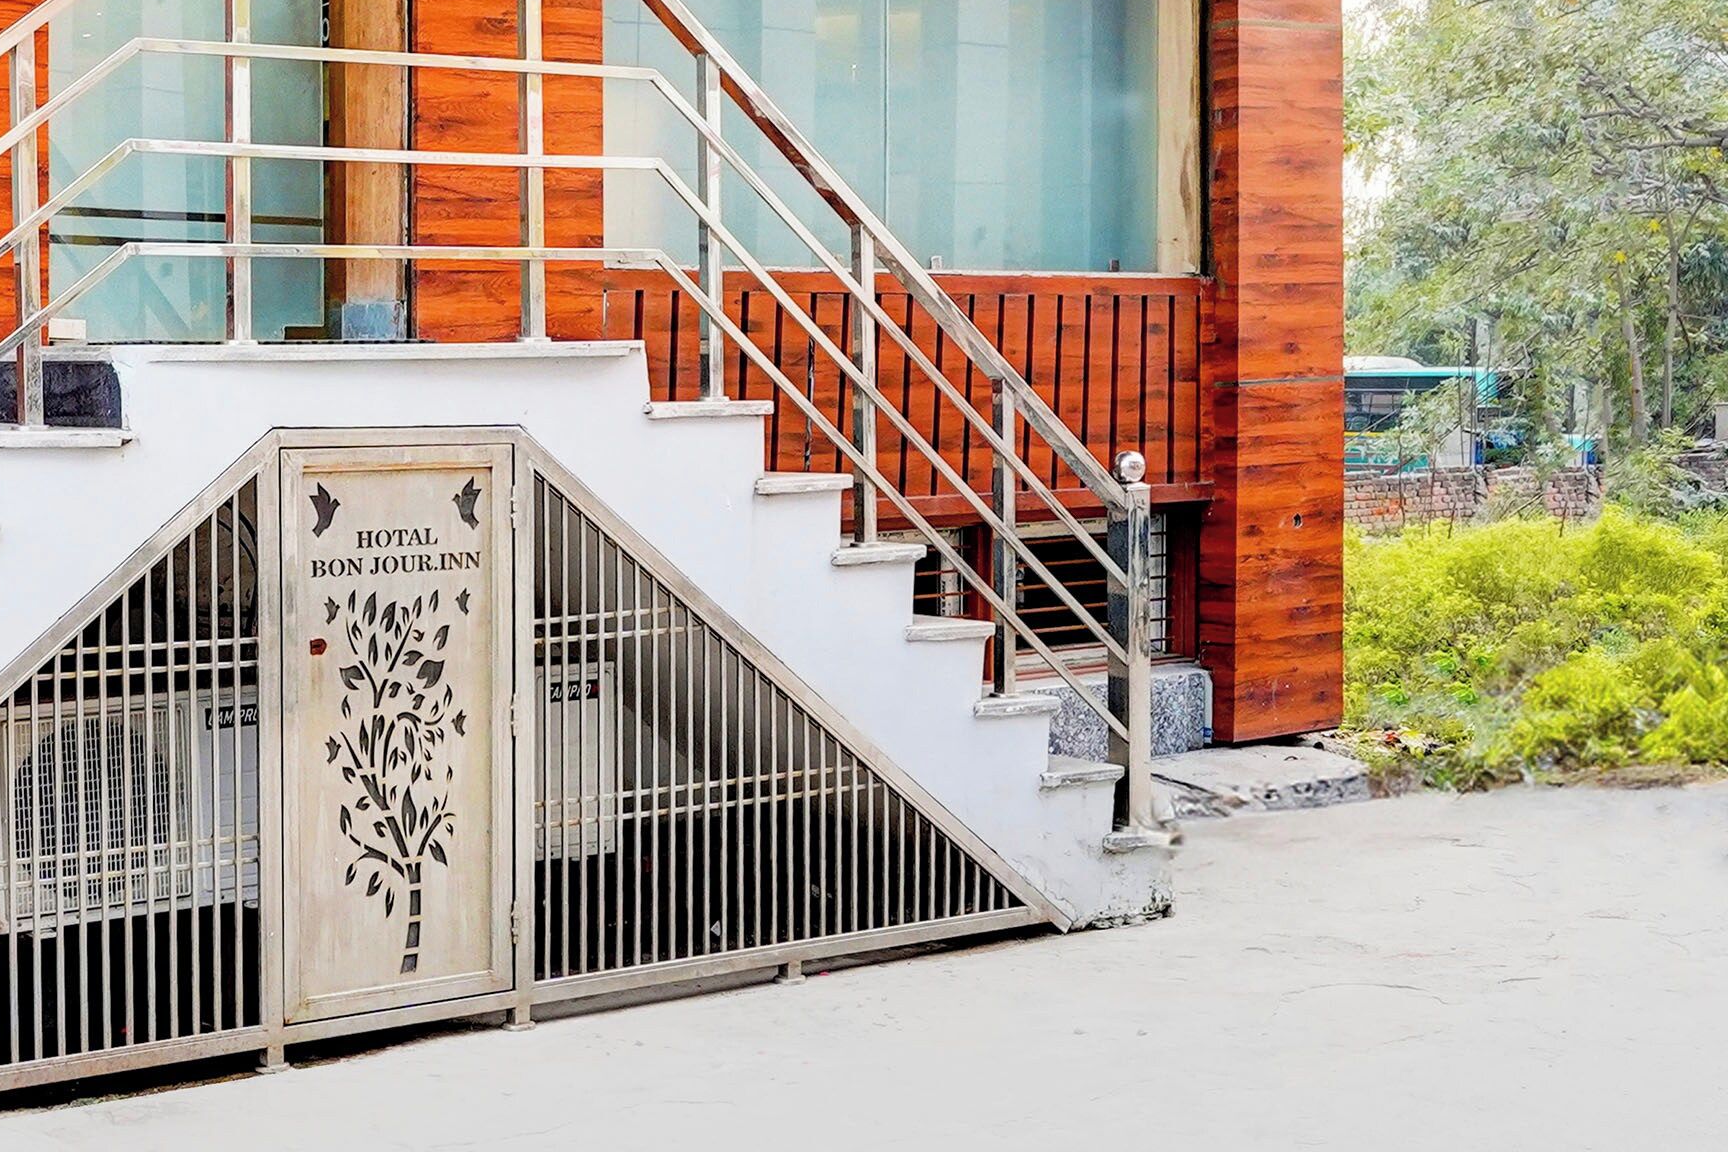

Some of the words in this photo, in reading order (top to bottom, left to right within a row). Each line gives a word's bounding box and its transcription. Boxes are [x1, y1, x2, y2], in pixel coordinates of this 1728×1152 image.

[356, 528, 438, 549] HOTAL
[311, 558, 363, 578] BON
[370, 551, 481, 575] JOUR.INN
